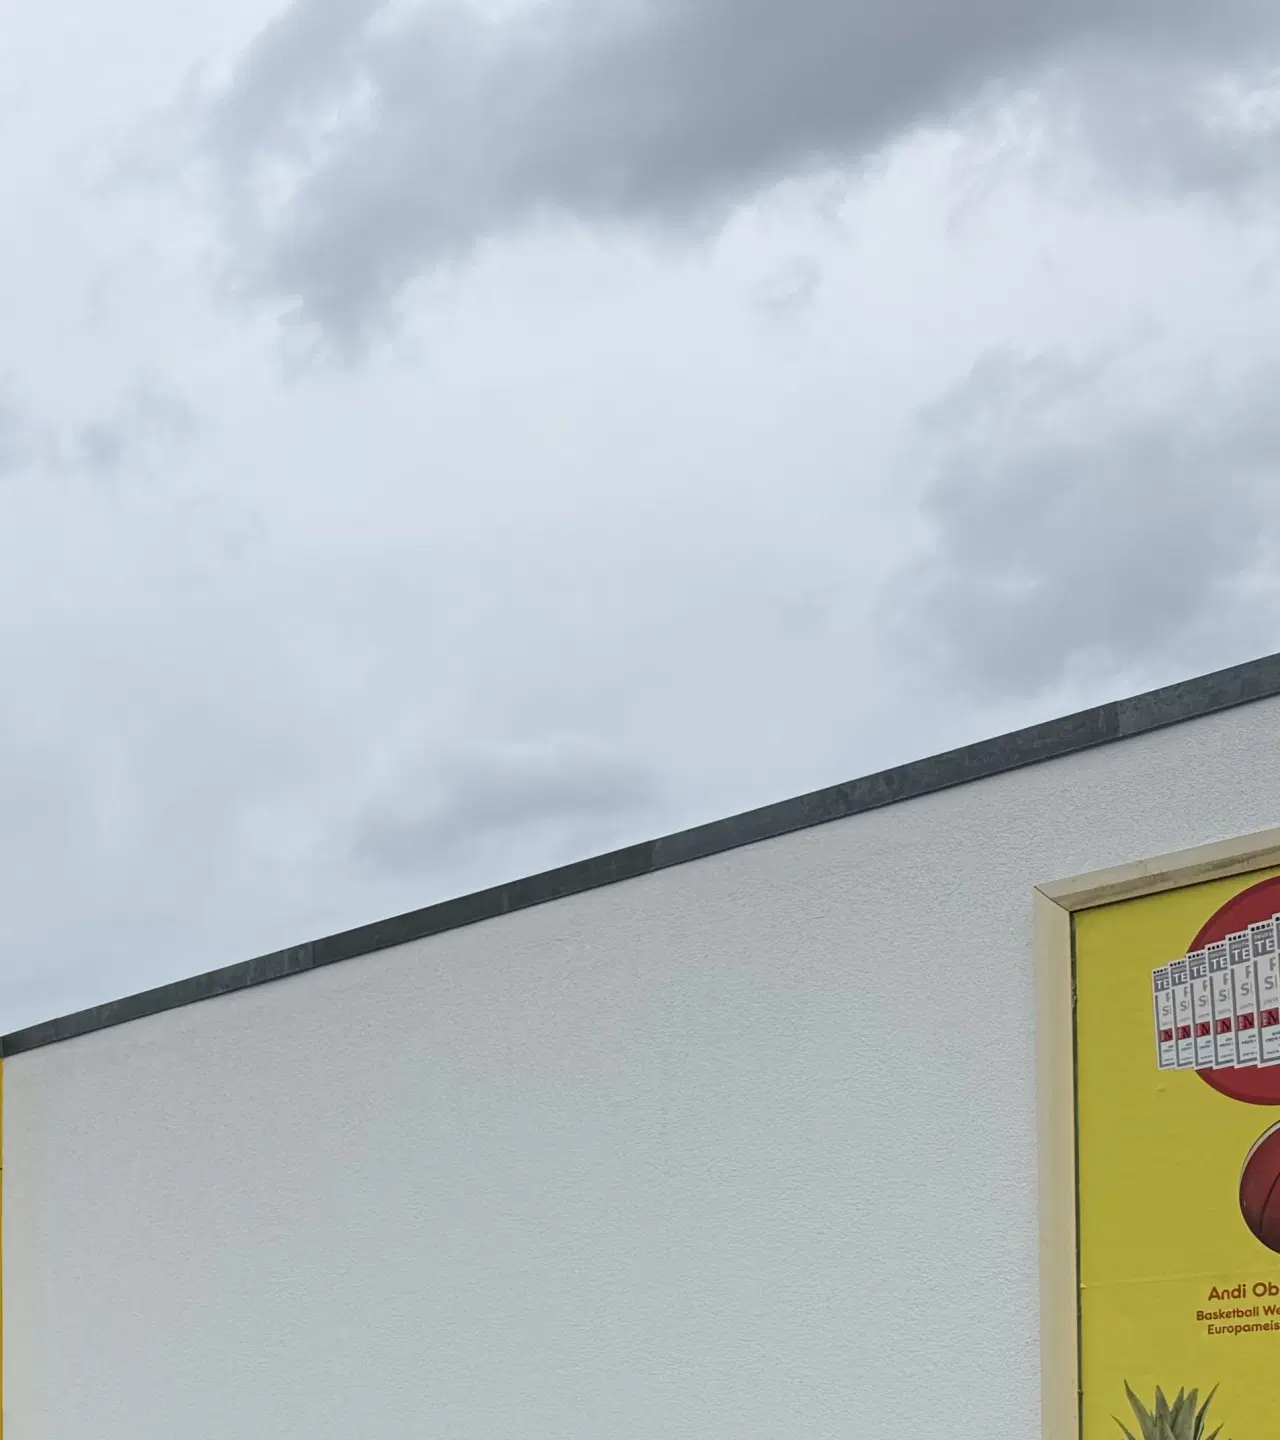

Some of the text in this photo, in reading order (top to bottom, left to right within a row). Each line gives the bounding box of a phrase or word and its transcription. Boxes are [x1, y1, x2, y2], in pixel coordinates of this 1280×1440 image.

[1208, 1282, 1280, 1301] Andi Ob
[1196, 1306, 1259, 1321] Basketball
[1207, 1320, 1280, 1336] Europameis
